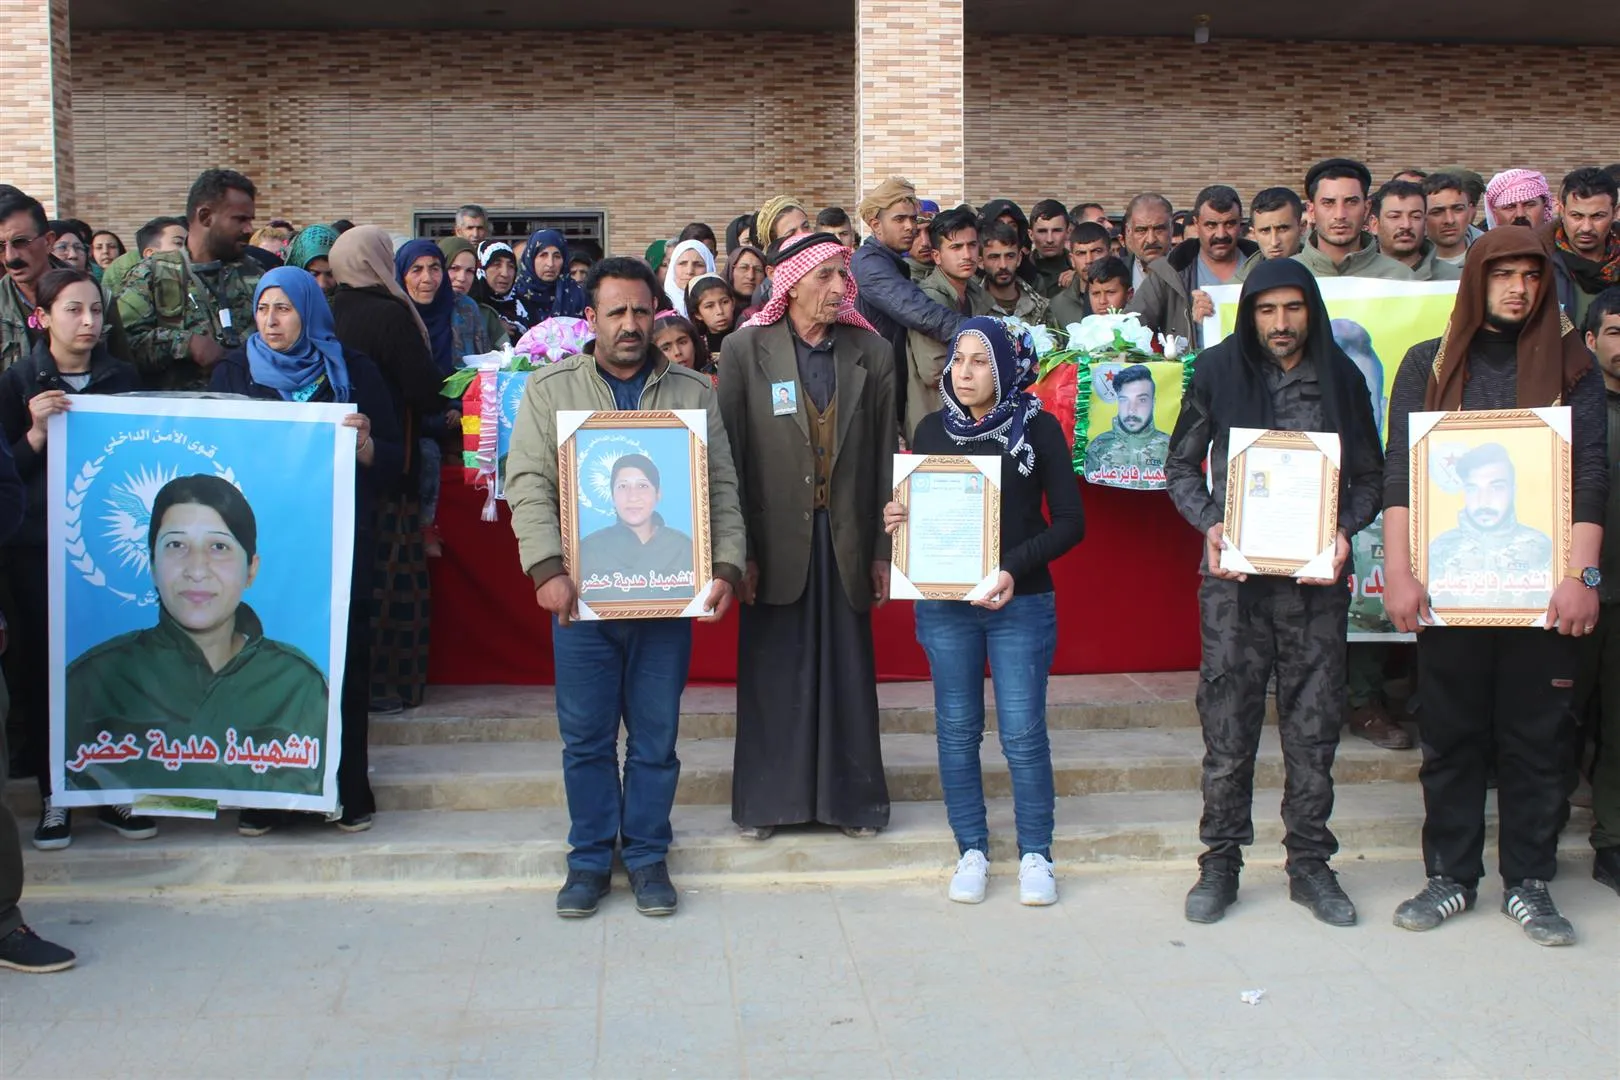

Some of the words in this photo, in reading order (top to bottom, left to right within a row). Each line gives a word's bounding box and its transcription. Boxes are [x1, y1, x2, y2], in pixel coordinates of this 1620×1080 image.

[104, 429, 149, 454] الداخلي
[187, 441, 218, 458] قوى
[66, 731, 143, 772] خضر
[146, 729, 219, 771] هدية
[224, 728, 320, 773] الشهيدة
